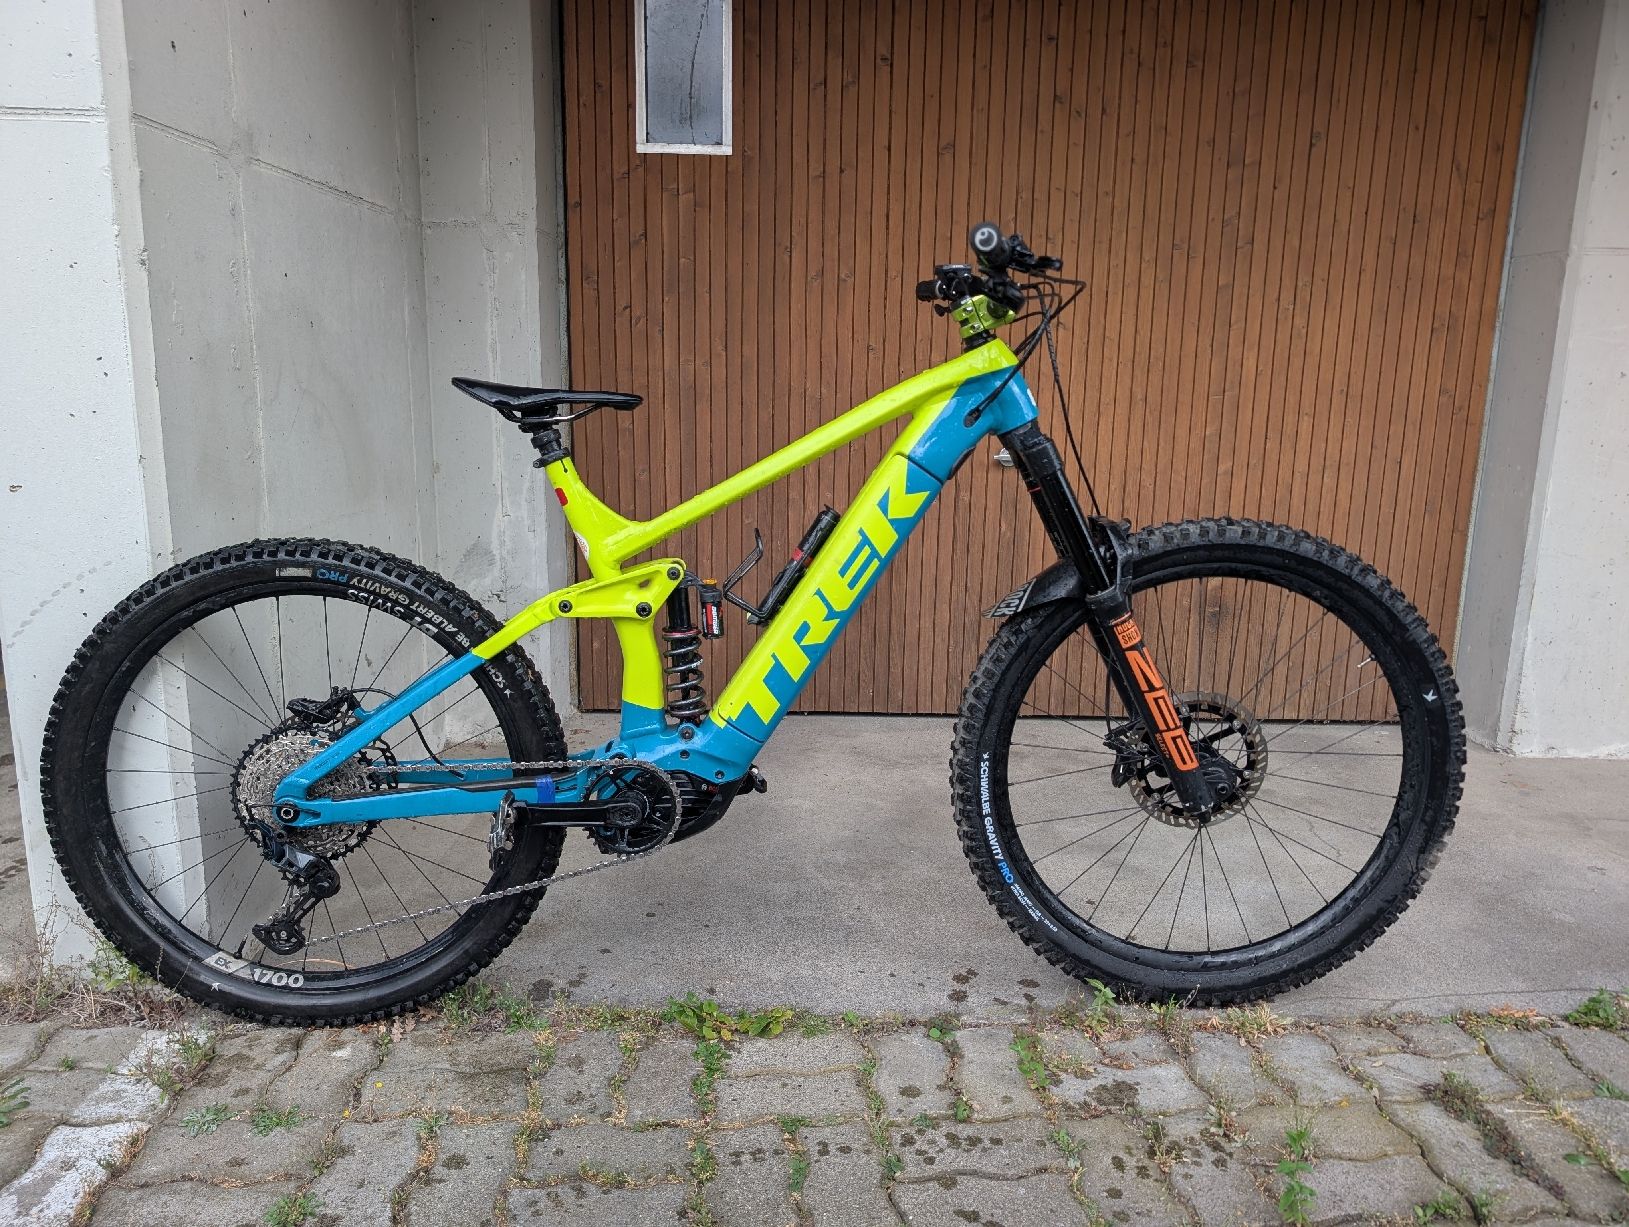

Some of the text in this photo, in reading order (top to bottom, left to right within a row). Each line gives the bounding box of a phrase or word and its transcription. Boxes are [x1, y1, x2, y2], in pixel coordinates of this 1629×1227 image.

[316, 568, 349, 583] PRO
[349, 576, 410, 605] GRAVITY
[725, 457, 931, 725] TREK
[347, 589, 439, 637] DT SWISS
[410, 601, 459, 632] ALBERT
[980, 761, 1014, 885] SCHWALBE GRAVITY PRO
[253, 968, 304, 988] 1700
